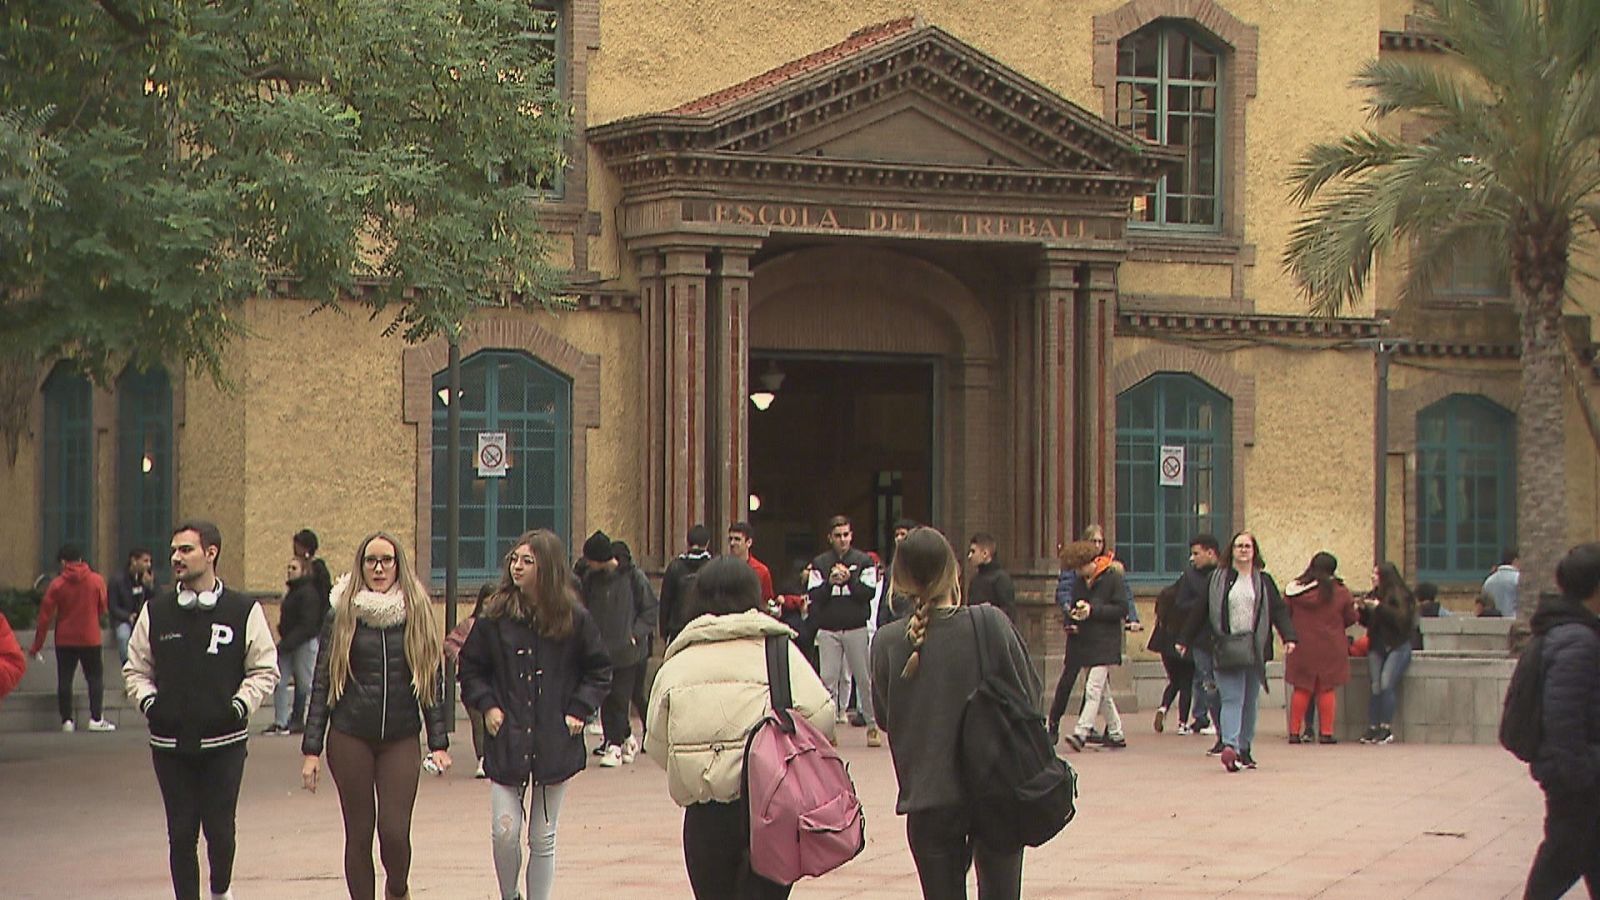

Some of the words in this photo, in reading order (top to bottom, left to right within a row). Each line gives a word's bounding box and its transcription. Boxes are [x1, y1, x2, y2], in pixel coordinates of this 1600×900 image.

[714, 203, 840, 229] ESCOLA
[868, 209, 932, 232] DEL
[206, 623, 234, 654] P
